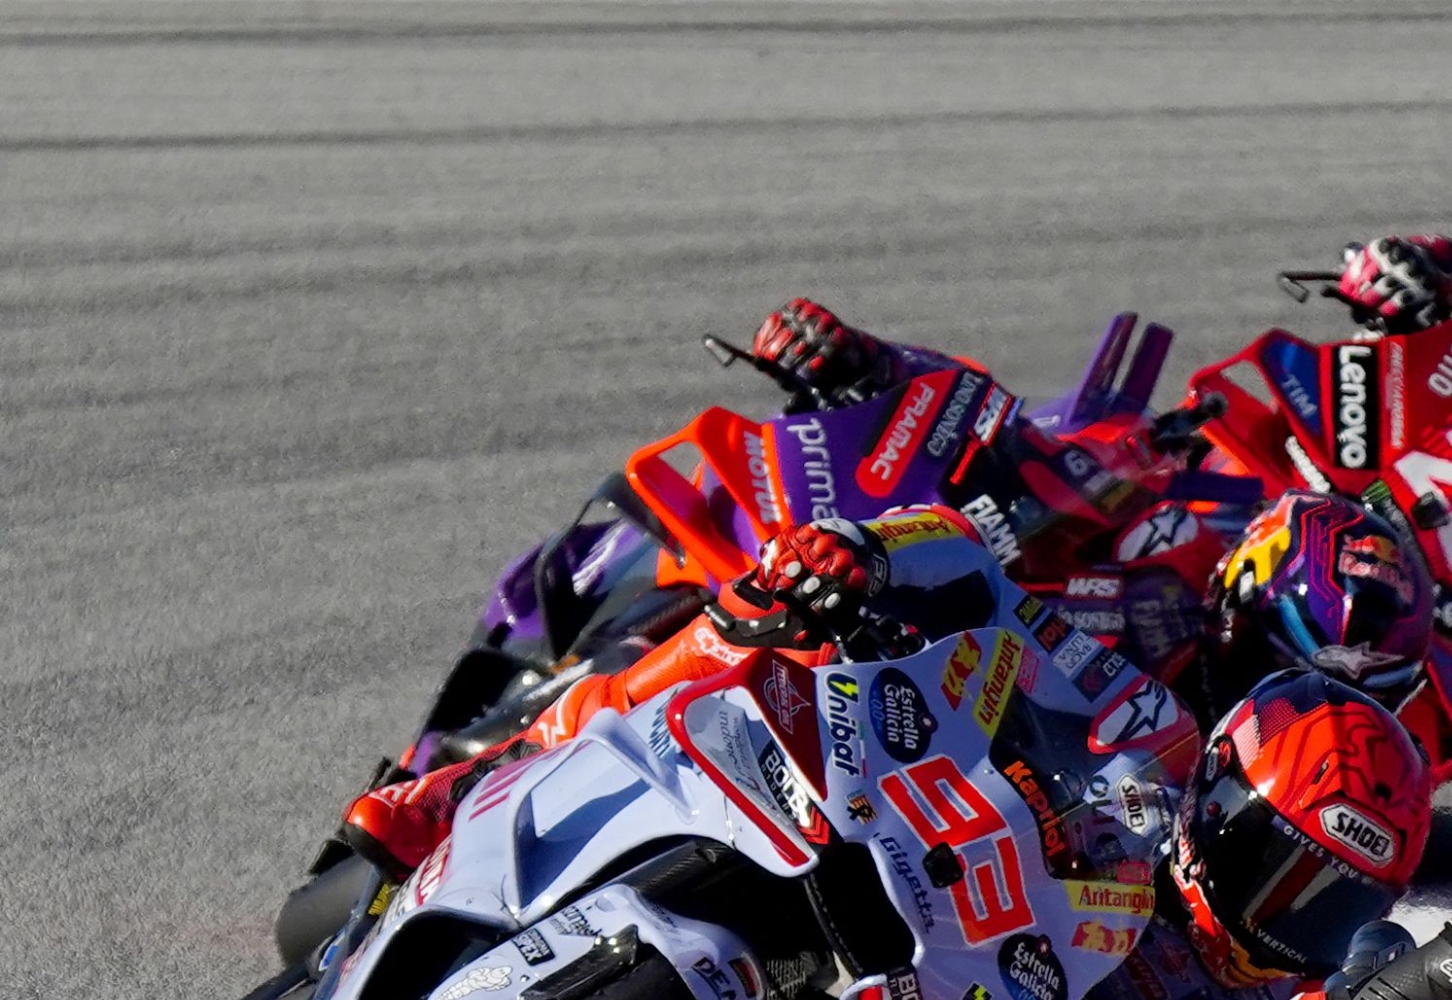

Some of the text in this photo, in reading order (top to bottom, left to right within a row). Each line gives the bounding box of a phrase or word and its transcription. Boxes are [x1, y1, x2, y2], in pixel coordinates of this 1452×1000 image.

[870, 381, 936, 481] PRAMAC
[1283, 373, 1318, 418] TIM
[1338, 344, 1369, 469] Lenovo
[743, 431, 783, 525] MOTUL
[787, 416, 838, 520] prima
[960, 494, 1022, 567] FIAMM
[823, 670, 861, 777] Unibat
[883, 683, 901, 743] Galicia
[896, 686, 918, 751] Estrella
[978, 634, 1023, 726] Antangin
[876, 755, 1038, 946] 93
[1004, 760, 1067, 857] Kapriol
[1282, 824, 1359, 880] GIVES YOU
[1331, 811, 1393, 859] SHOEI
[1013, 939, 1061, 992] Estrella
